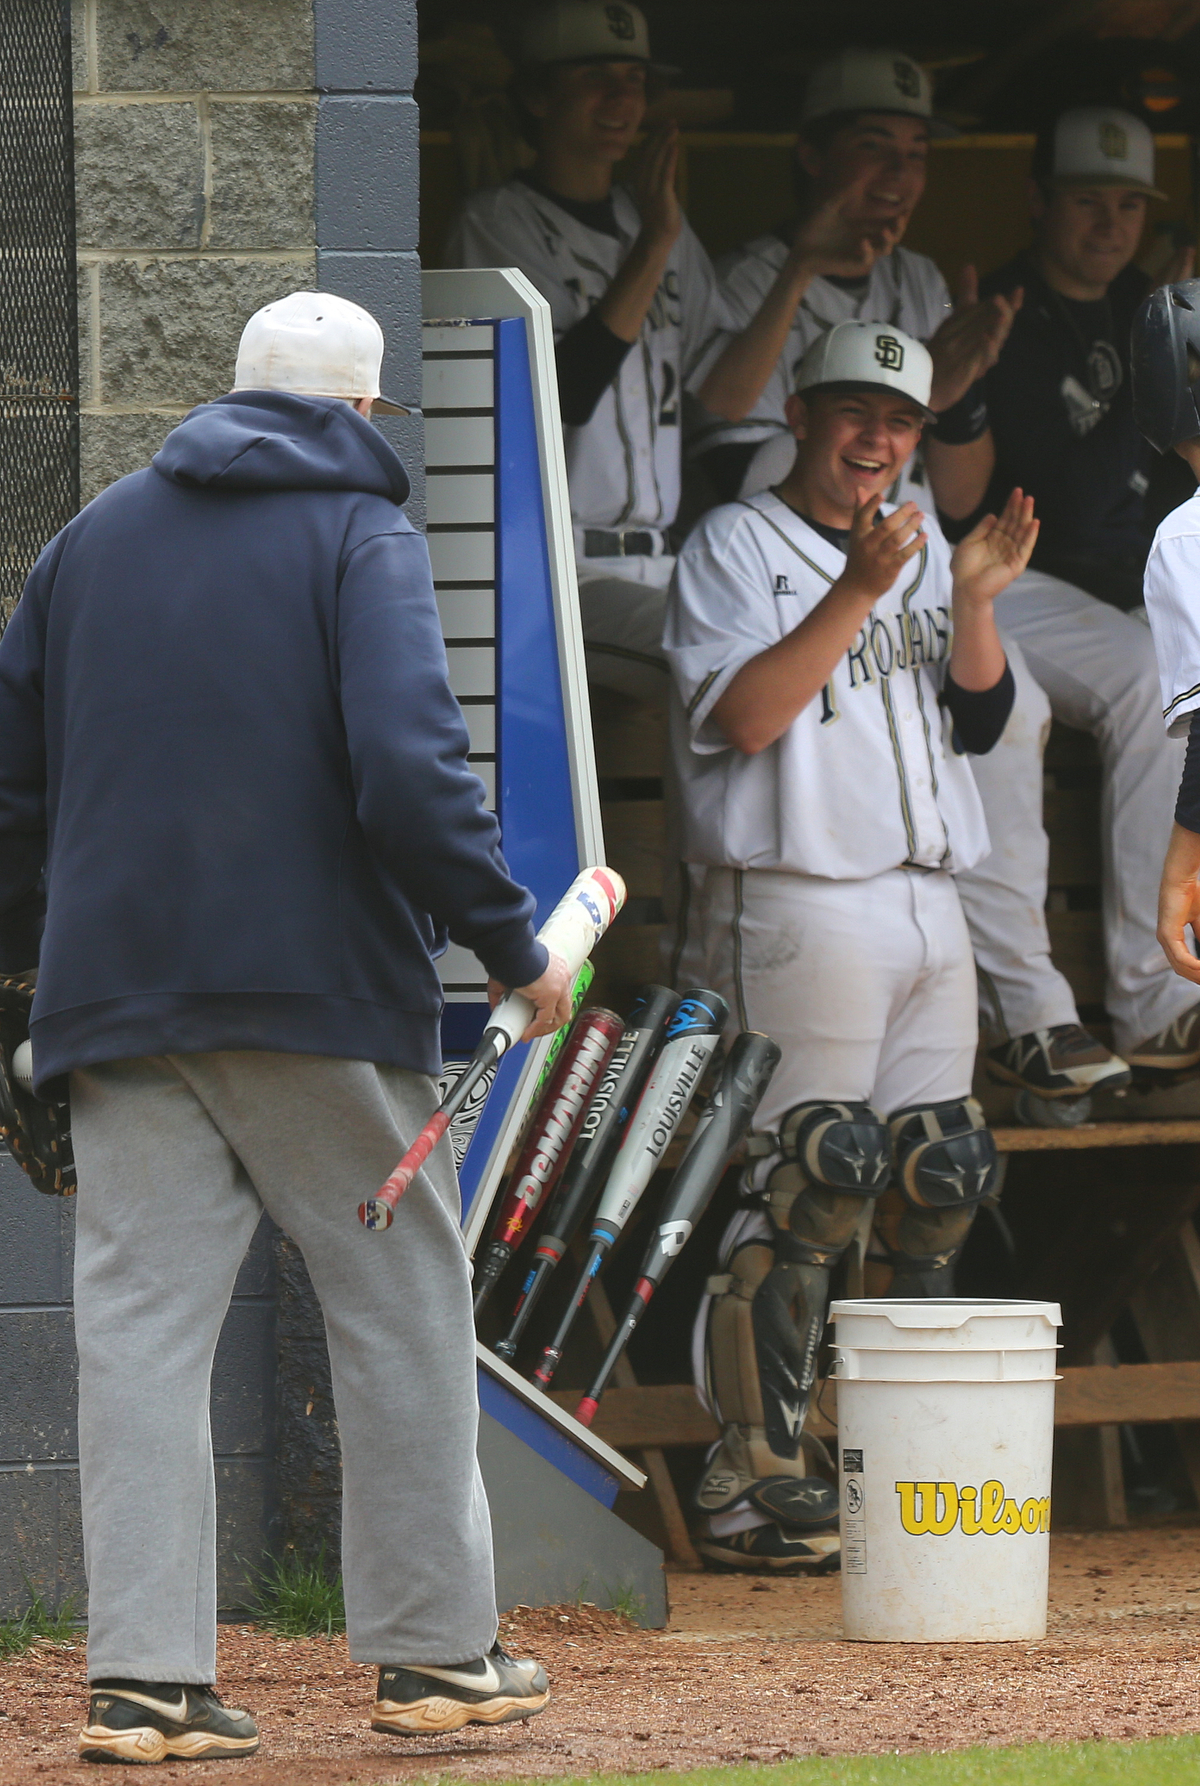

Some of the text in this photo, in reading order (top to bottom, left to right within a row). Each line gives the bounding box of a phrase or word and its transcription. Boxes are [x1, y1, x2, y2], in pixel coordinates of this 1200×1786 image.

[875, 335, 905, 372] SD
[579, 1031, 640, 1141] LOUISVILLE
[646, 1044, 707, 1159] LOUISVILLE
[896, 1479, 1050, 1536] Wilson
